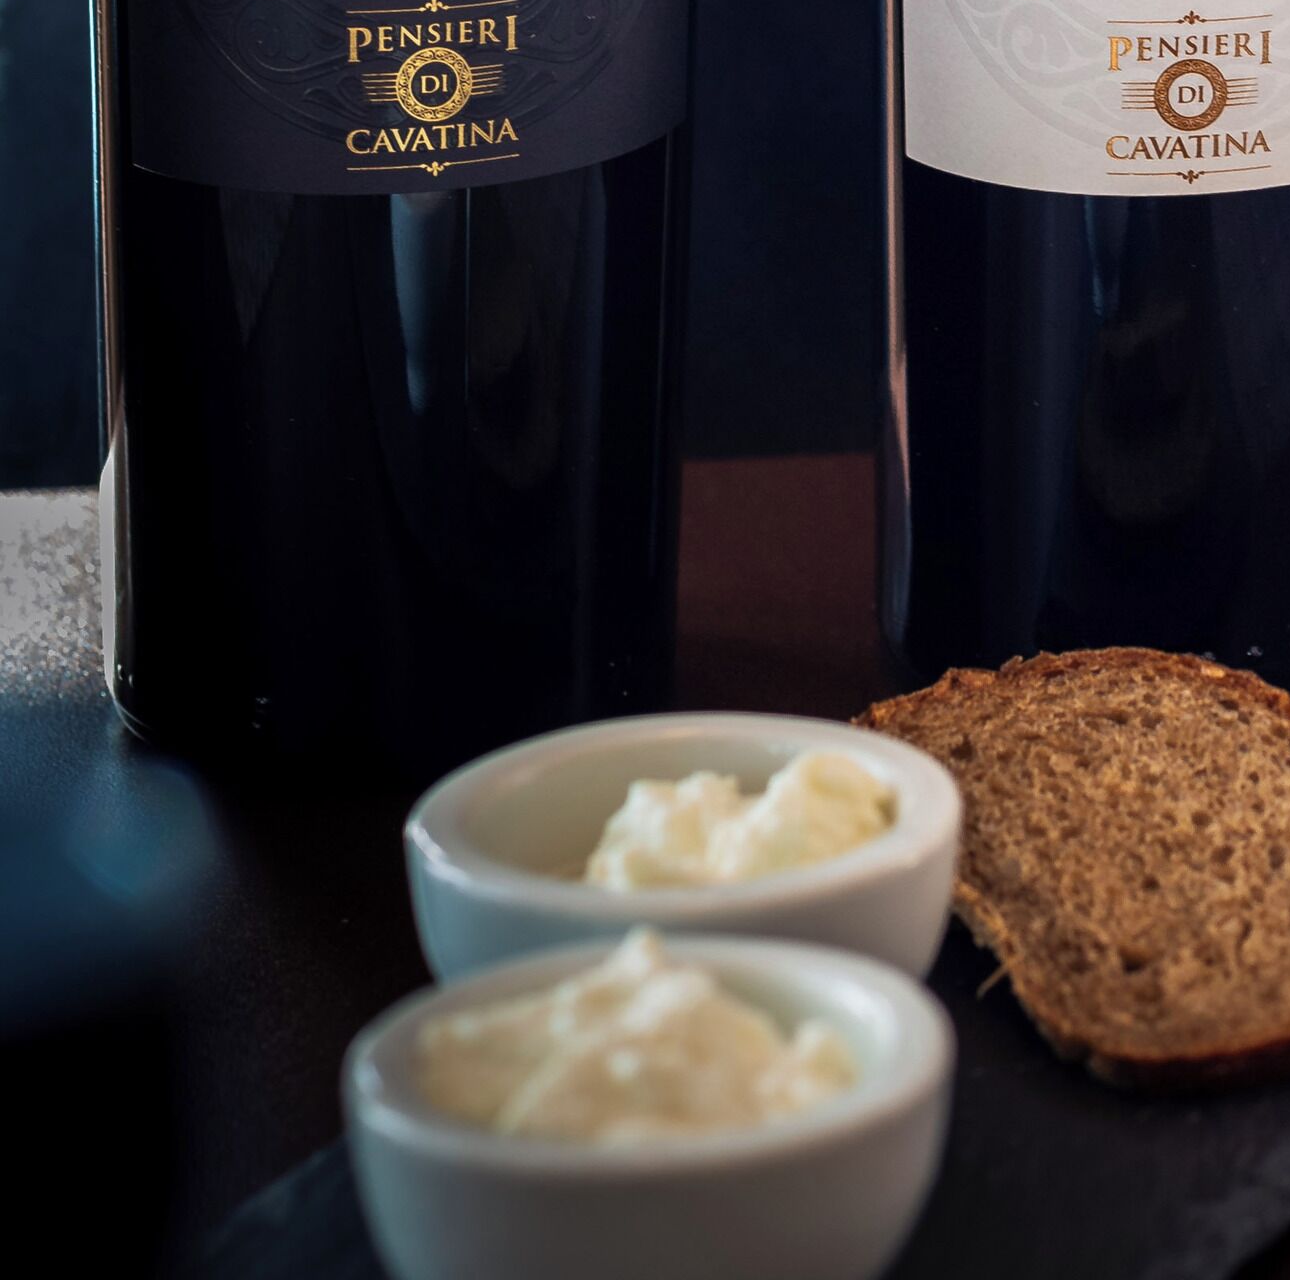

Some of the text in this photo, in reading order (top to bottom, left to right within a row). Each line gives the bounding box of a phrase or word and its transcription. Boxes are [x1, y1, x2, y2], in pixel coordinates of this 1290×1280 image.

[346, 14, 519, 63] PENSIERI
[1107, 30, 1272, 72] PENSIERI
[420, 73, 450, 94] DI
[1177, 85, 1205, 104] DI
[345, 117, 520, 155] CAVATINA
[1105, 129, 1272, 160] CAVATINA
